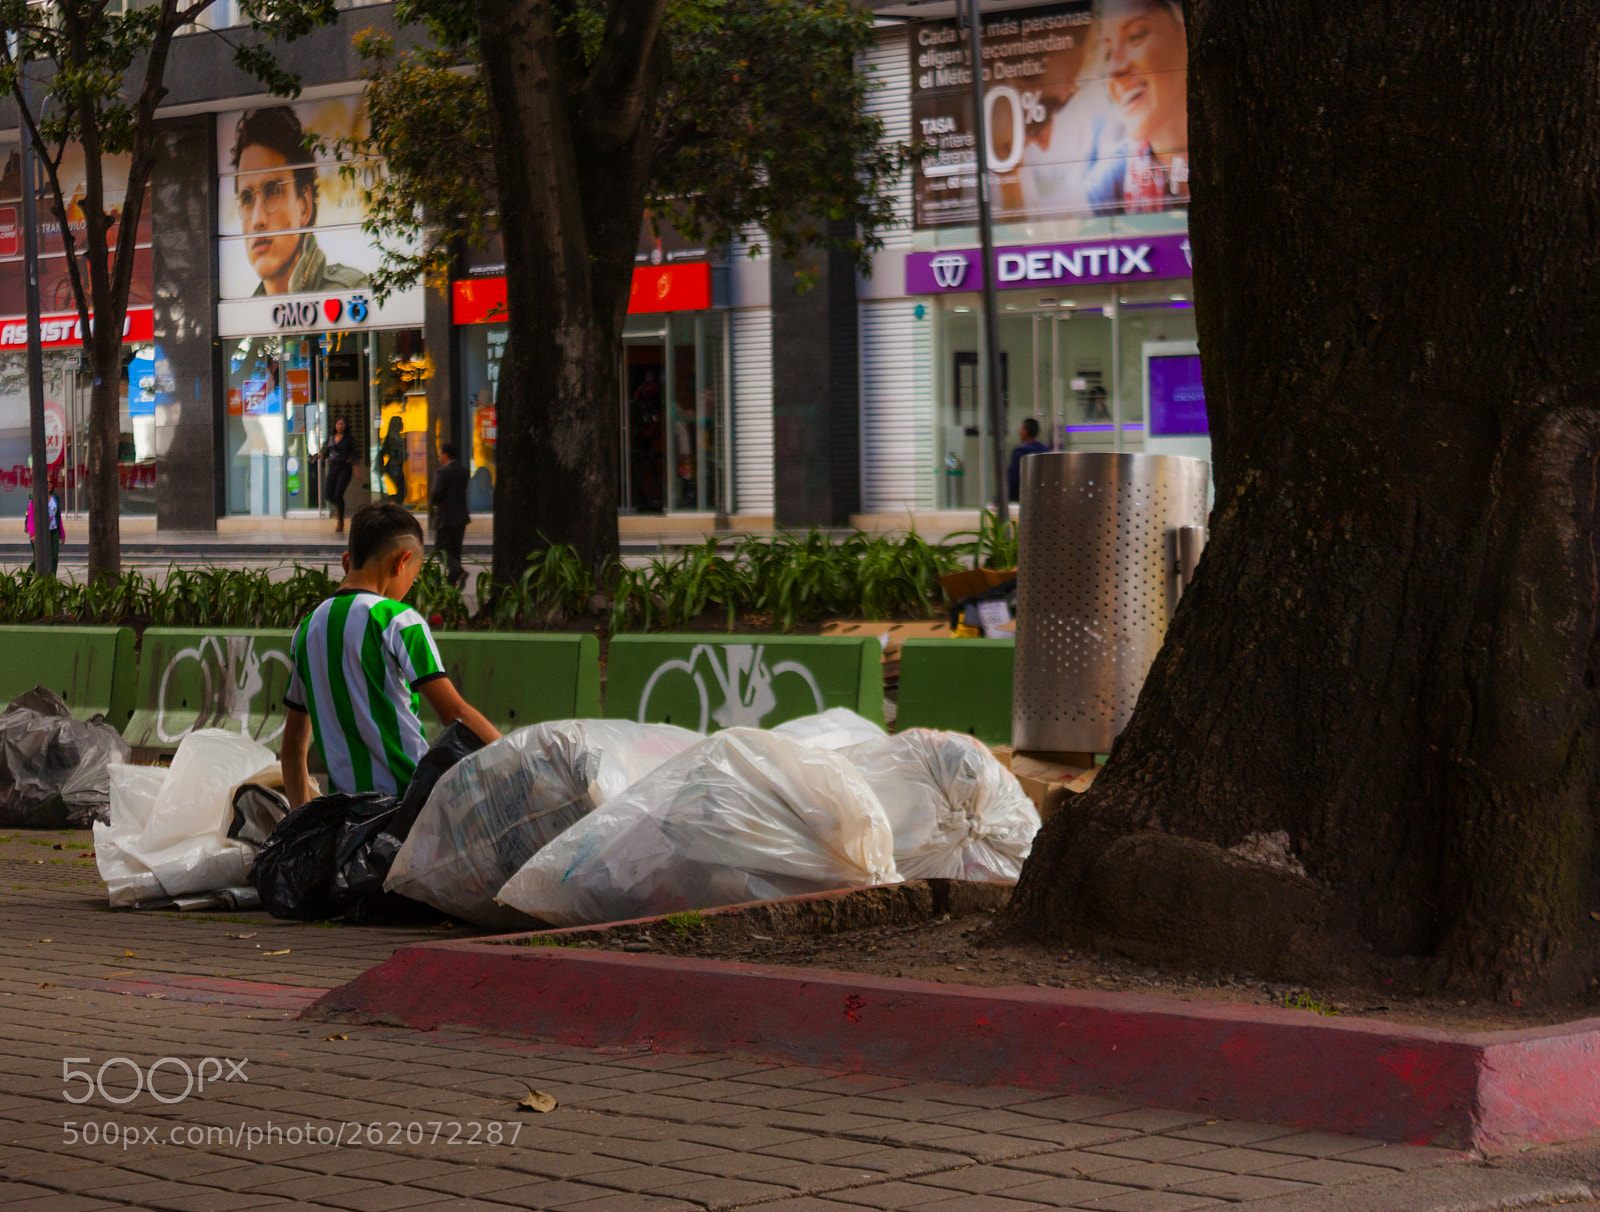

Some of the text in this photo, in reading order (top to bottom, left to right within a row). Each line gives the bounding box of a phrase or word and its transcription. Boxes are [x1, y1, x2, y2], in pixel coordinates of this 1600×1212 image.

[918, 27, 957, 46] Cada
[987, 19, 1020, 37] más
[918, 49, 963, 69] eligen
[980, 34, 1074, 59] ecomiendan
[918, 70, 935, 89] el
[920, 116, 956, 135] TASA
[997, 244, 1152, 282] DENTIX
[272, 301, 319, 328] GMO
[1, 319, 75, 345] ASIST
